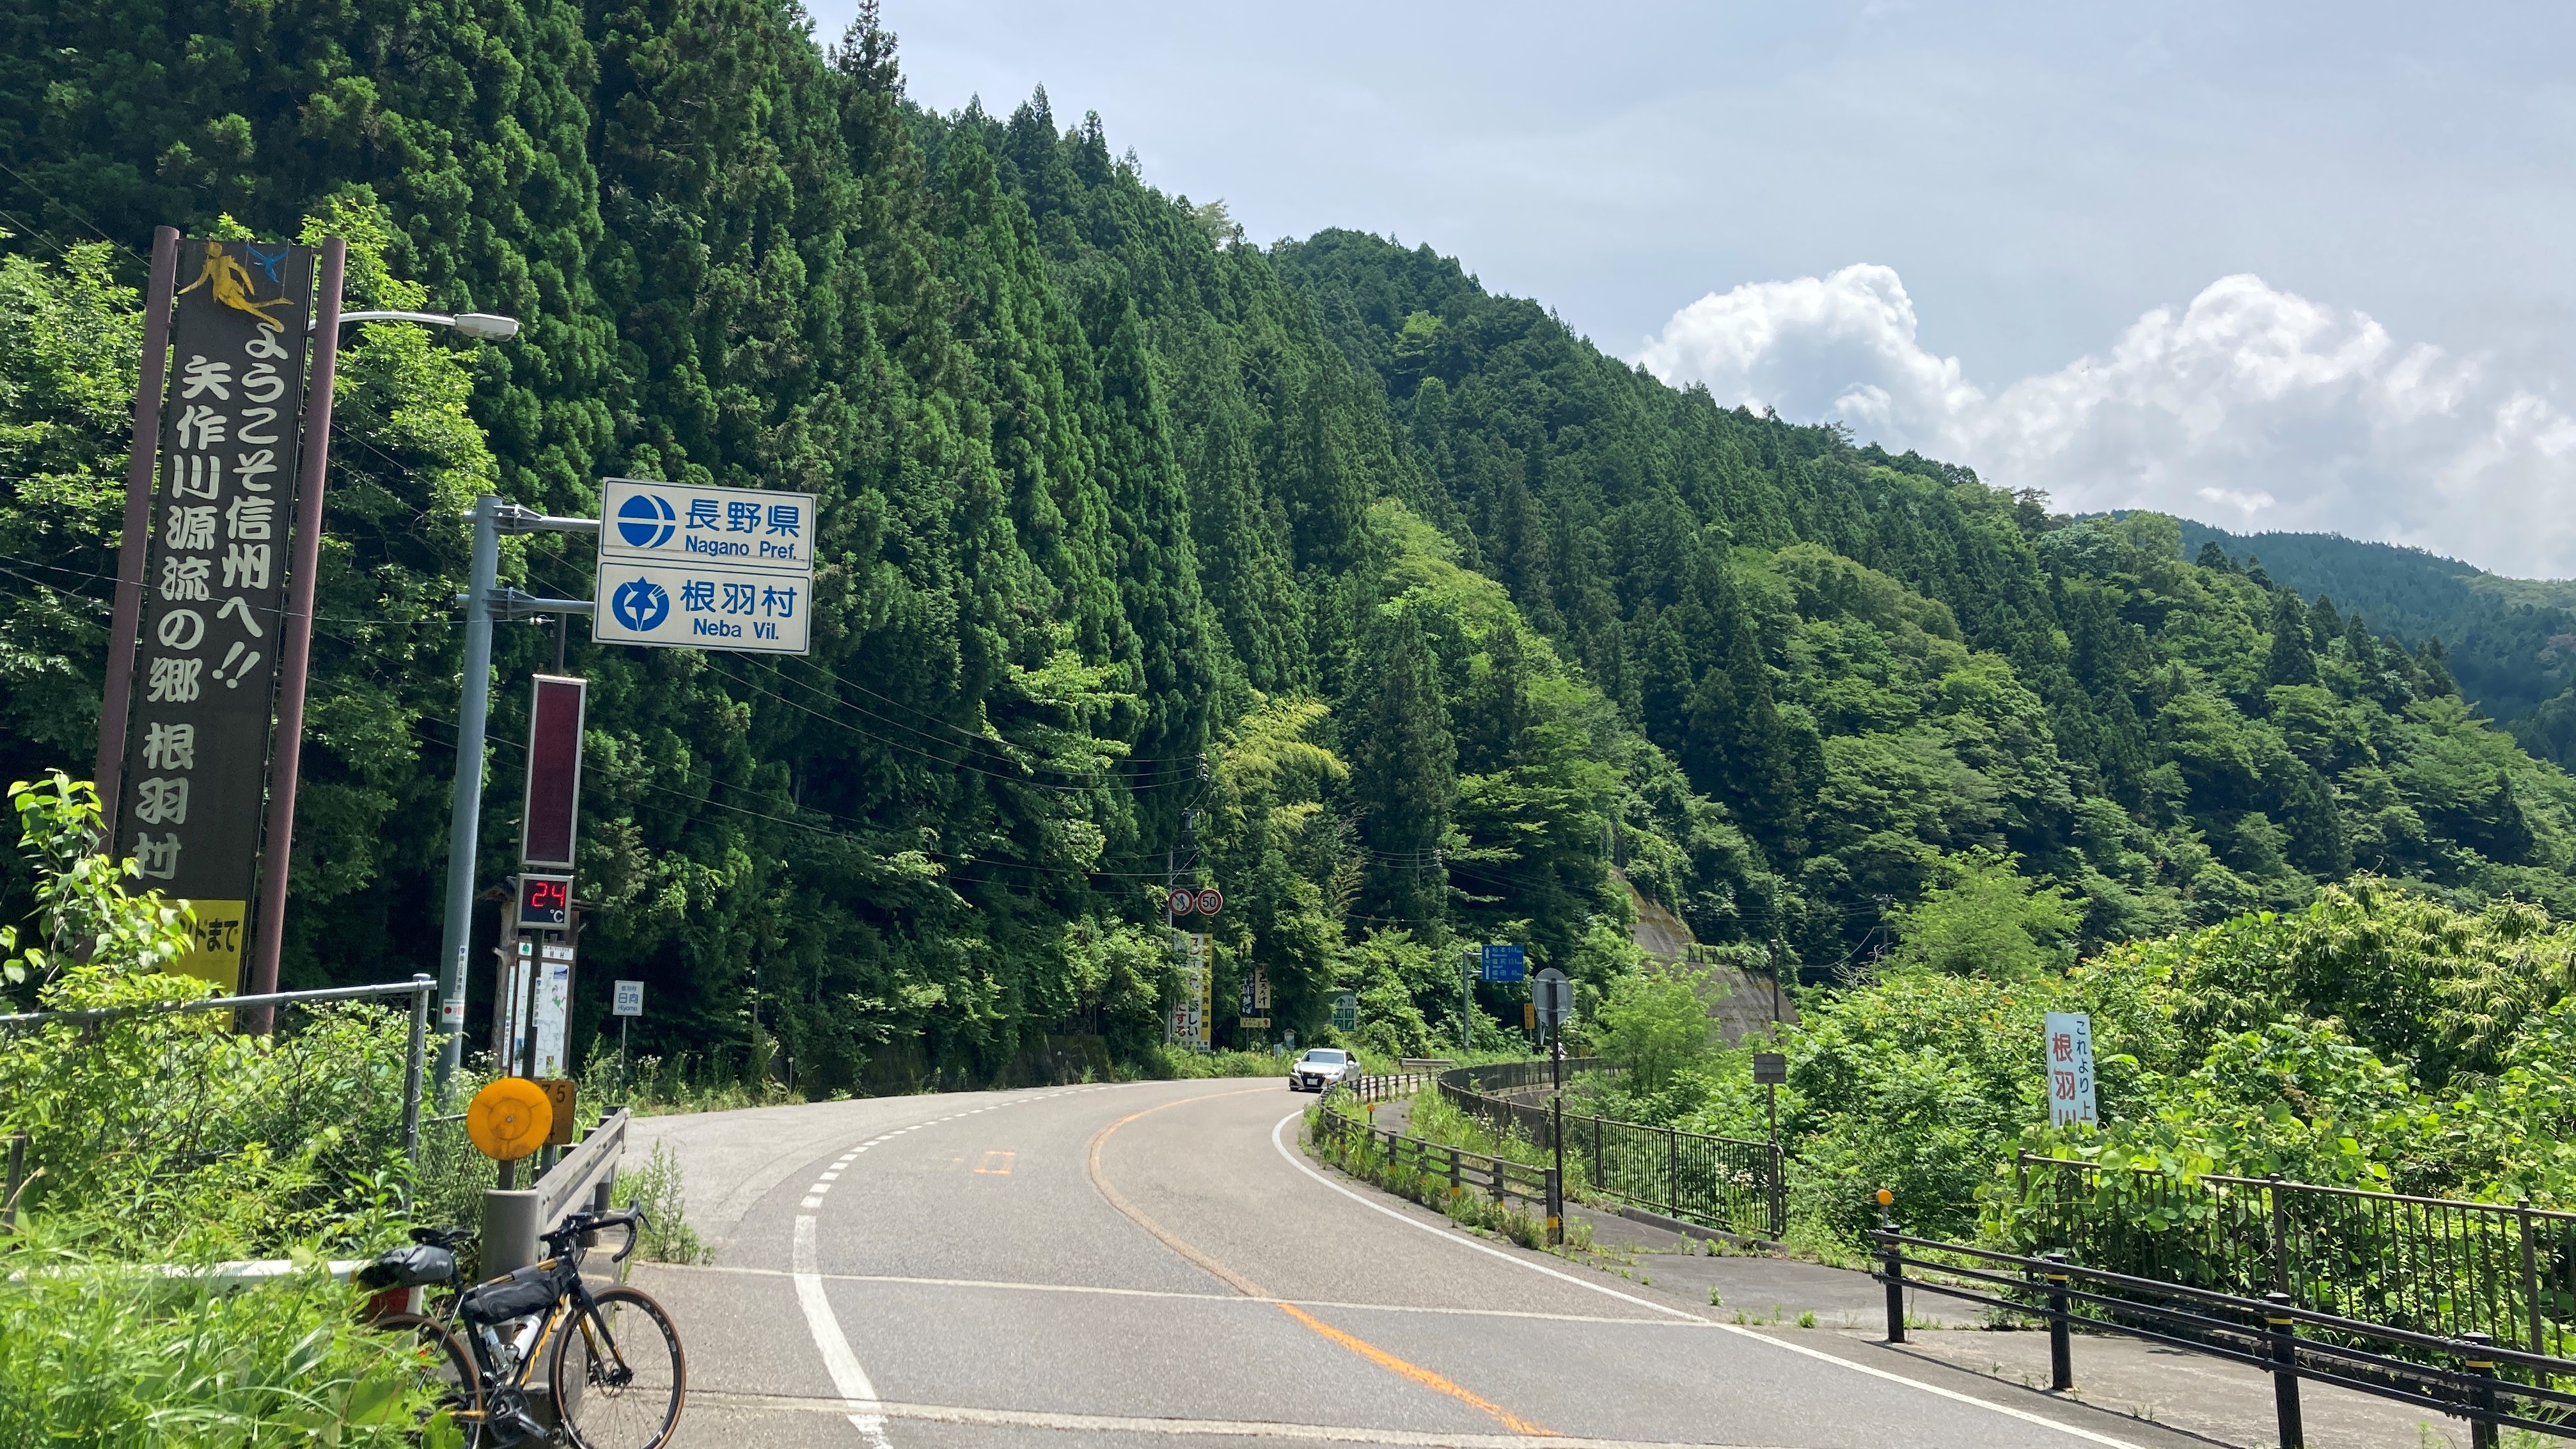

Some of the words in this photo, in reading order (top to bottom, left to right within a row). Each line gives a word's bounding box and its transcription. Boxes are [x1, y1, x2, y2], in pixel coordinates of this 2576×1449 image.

[146, 356, 232, 704] 矢作川源流の郷
[685, 498, 800, 538] 長野県
[685, 535, 750, 558] Nagano
[759, 541, 797, 560] Pref.
[680, 579, 797, 617] 根羽村
[693, 617, 742, 638] Neba
[753, 622, 780, 640] Vil.
[132, 722, 195, 880] 根羽村
[531, 882, 566, 908] 24
[1202, 896, 1216, 908] 50
[618, 993, 639, 1004] 日向
[2052, 1032, 2077, 1126] 根羽川
